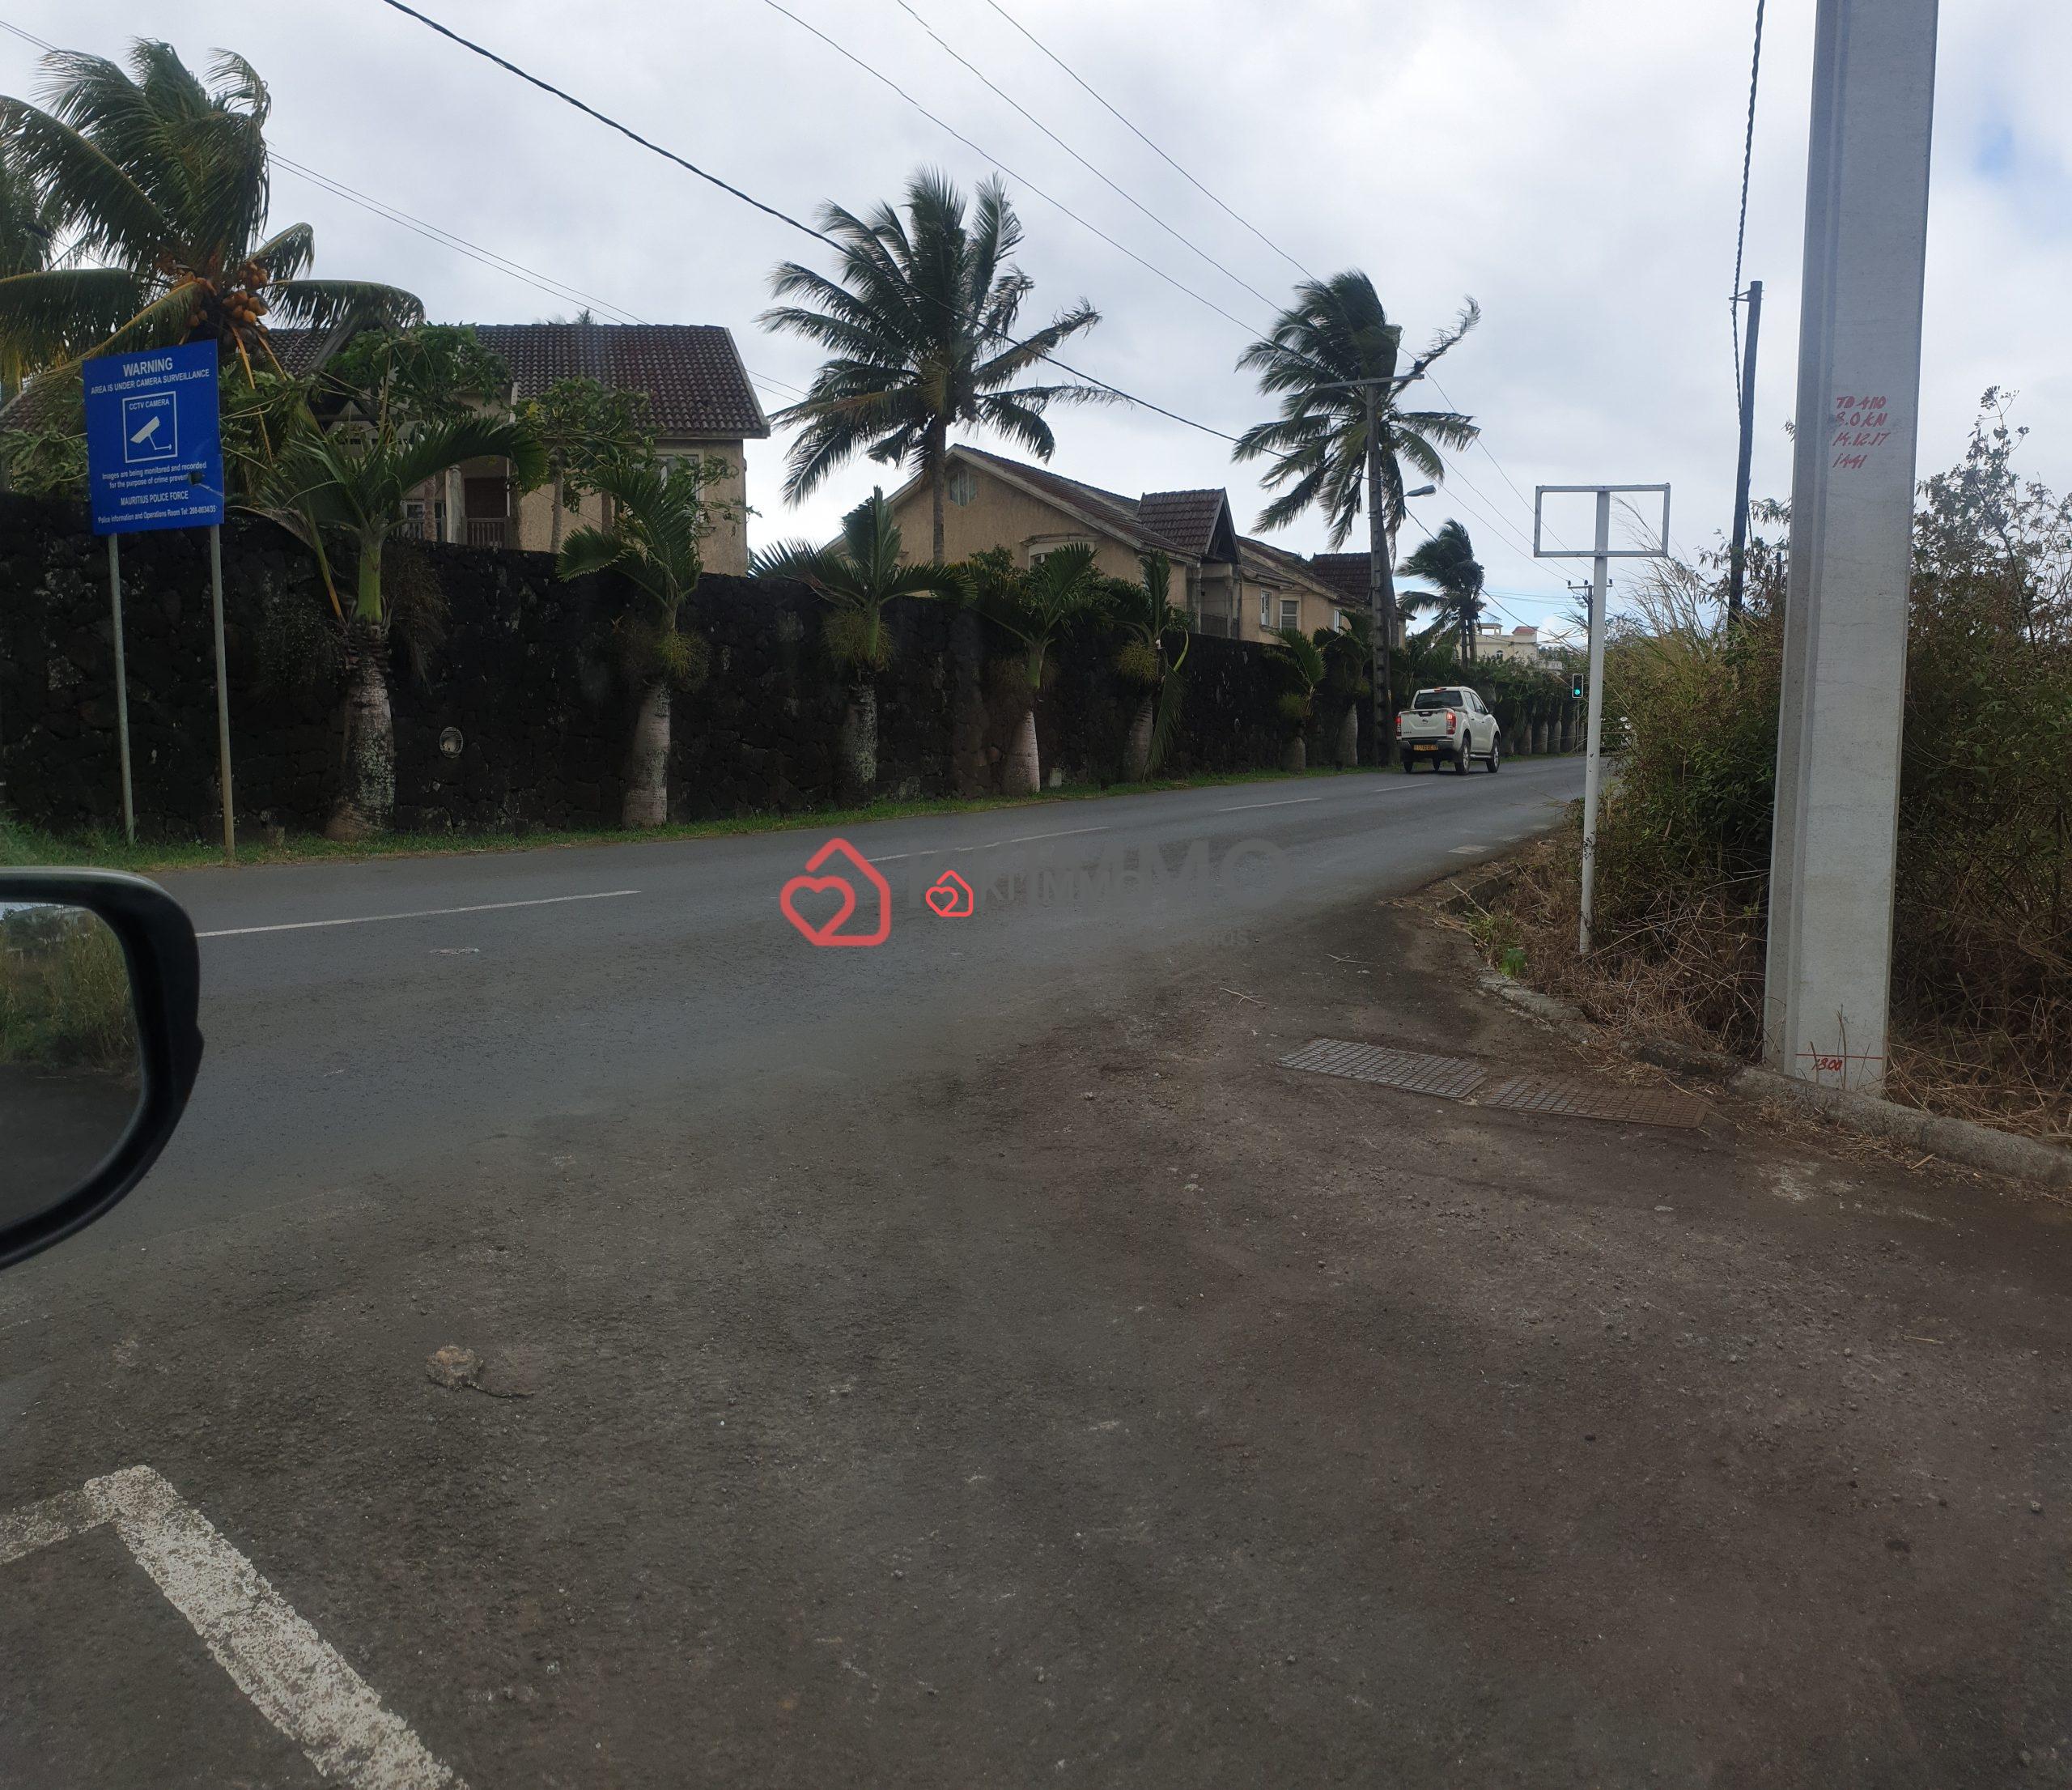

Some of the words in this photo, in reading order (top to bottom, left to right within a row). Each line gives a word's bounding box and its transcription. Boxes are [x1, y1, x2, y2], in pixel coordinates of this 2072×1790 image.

[123, 357, 173, 376] WARNING
[91, 383, 107, 394] AREA
[108, 384, 113, 393] IS
[114, 380, 135, 391] UNDER
[136, 376, 162, 389] CAMERA
[163, 368, 210, 384] SURVEILLANCE
[129, 401, 145, 410] CCTV
[145, 398, 170, 408] CAMERA
[130, 469, 143, 477] being
[144, 465, 170, 474] monitored
[171, 464, 180, 472] and
[181, 461, 207, 470] recorded
[126, 478, 146, 488] purpose
[121, 495, 149, 506] MAURITIUS
[150, 492, 168, 503] POLICE
[169, 491, 189, 500] FORCE
